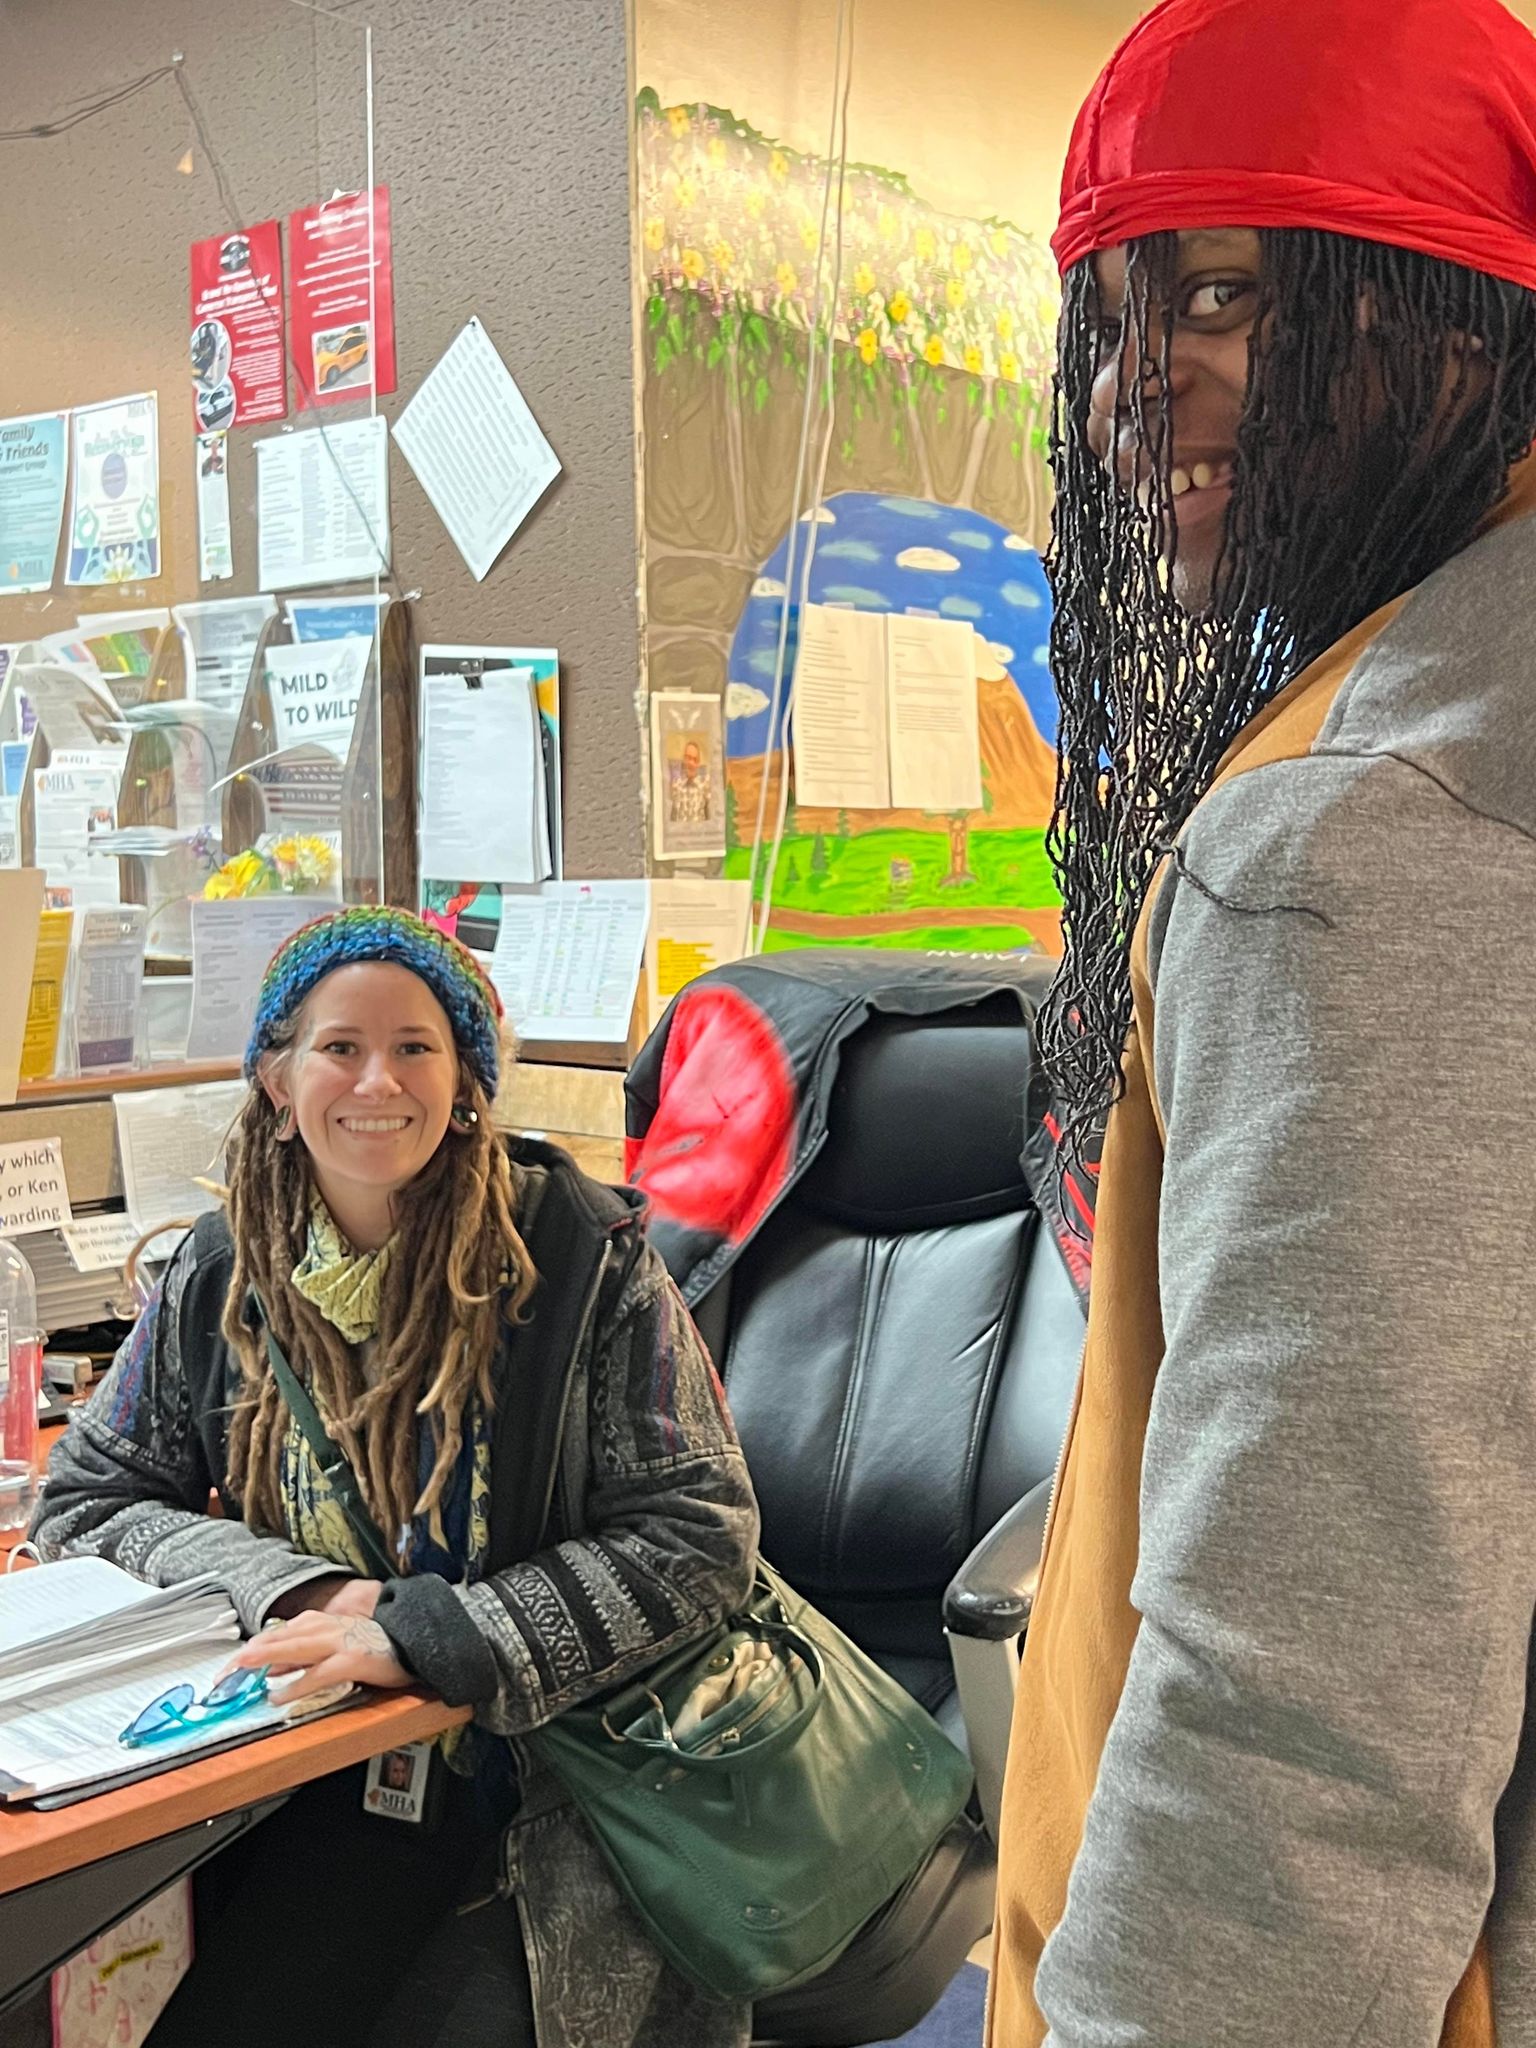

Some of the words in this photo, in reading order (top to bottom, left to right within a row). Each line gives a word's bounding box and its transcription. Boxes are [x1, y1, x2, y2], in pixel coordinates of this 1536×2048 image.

[0, 425, 35, 443] amily
[281, 673, 328, 695] MILD
[285, 705, 309, 726] TO
[315, 700, 360, 722] WILD
[11, 1149, 56, 1169] which
[8, 1185, 25, 1198] or
[28, 1179, 59, 1195] Ken
